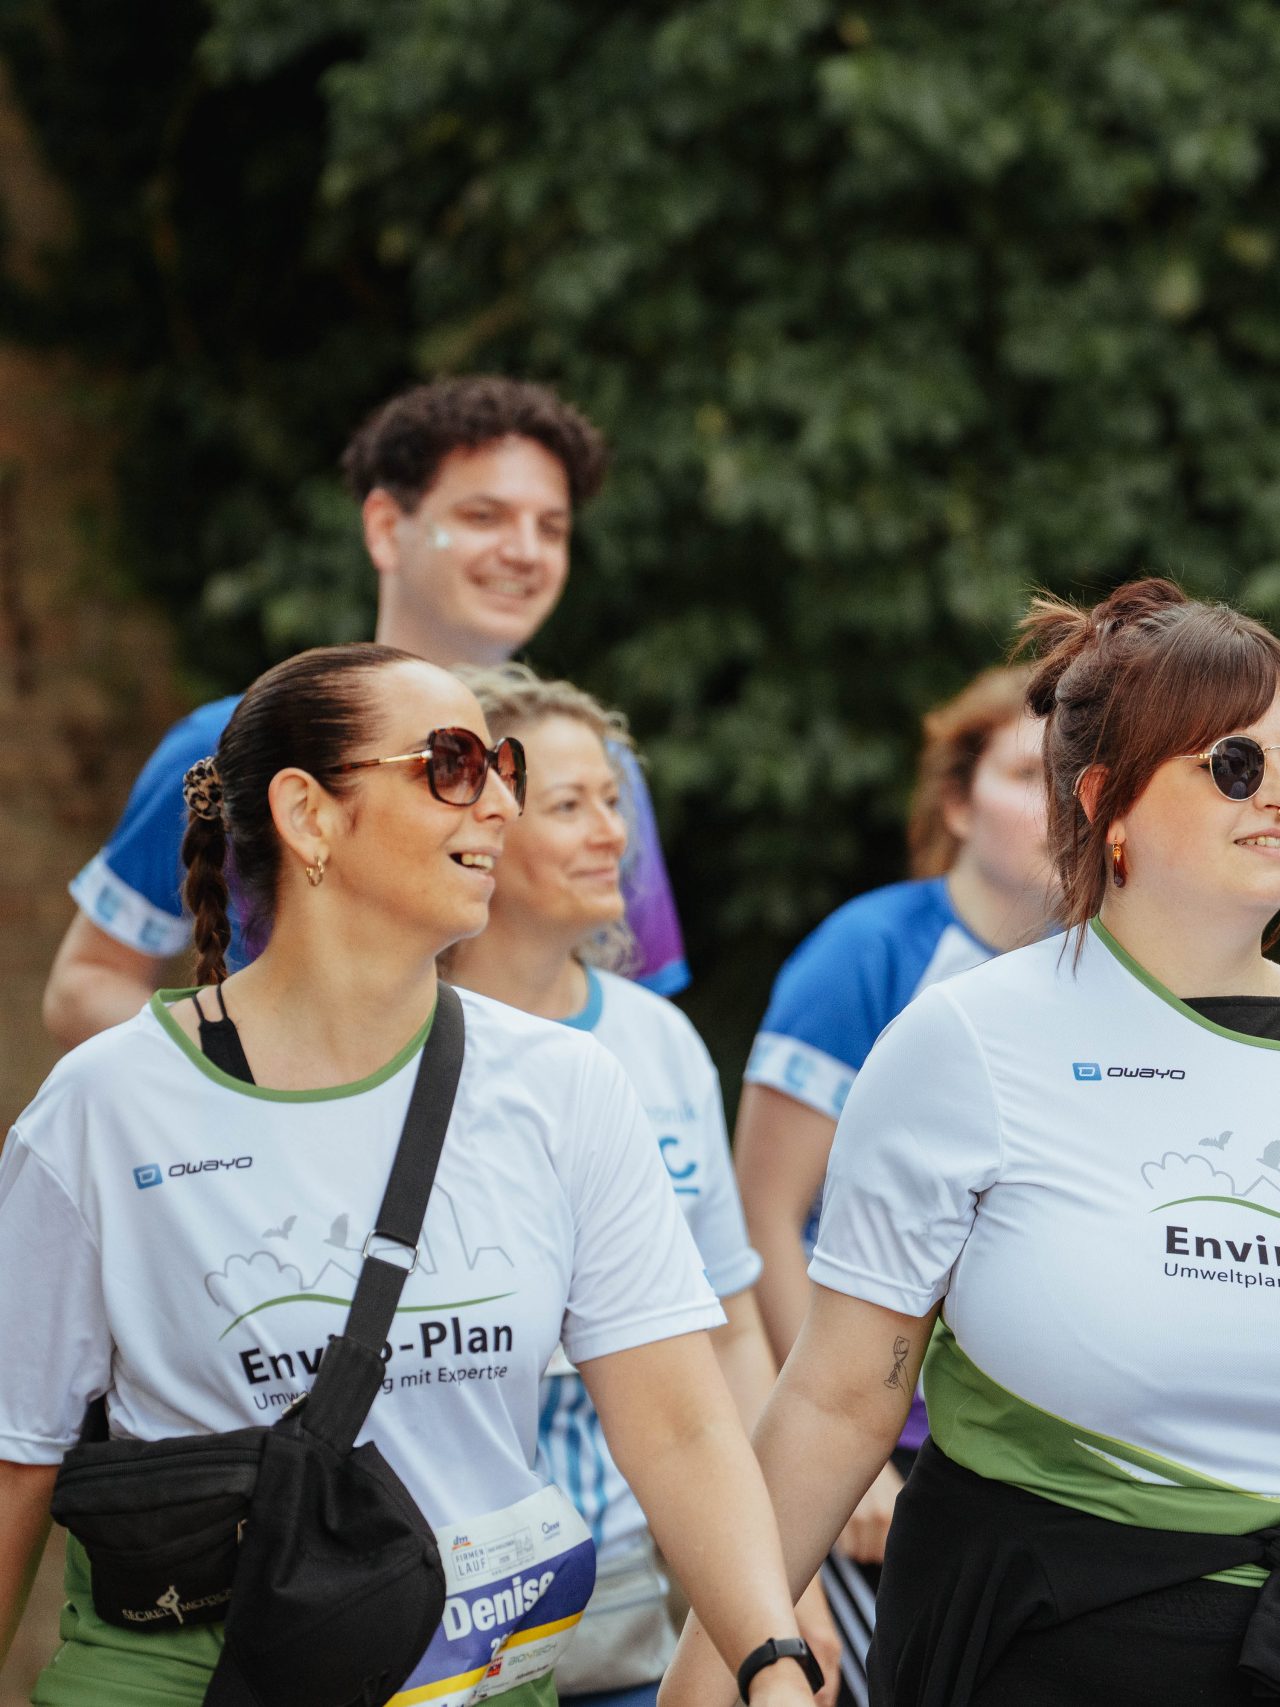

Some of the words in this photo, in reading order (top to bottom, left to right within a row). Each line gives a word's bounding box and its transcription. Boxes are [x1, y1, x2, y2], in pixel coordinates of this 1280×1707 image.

[400, 1368, 431, 1388] mit
[455, 1548, 484, 1563] FIRMEN
[458, 1558, 486, 1577] LAUF
